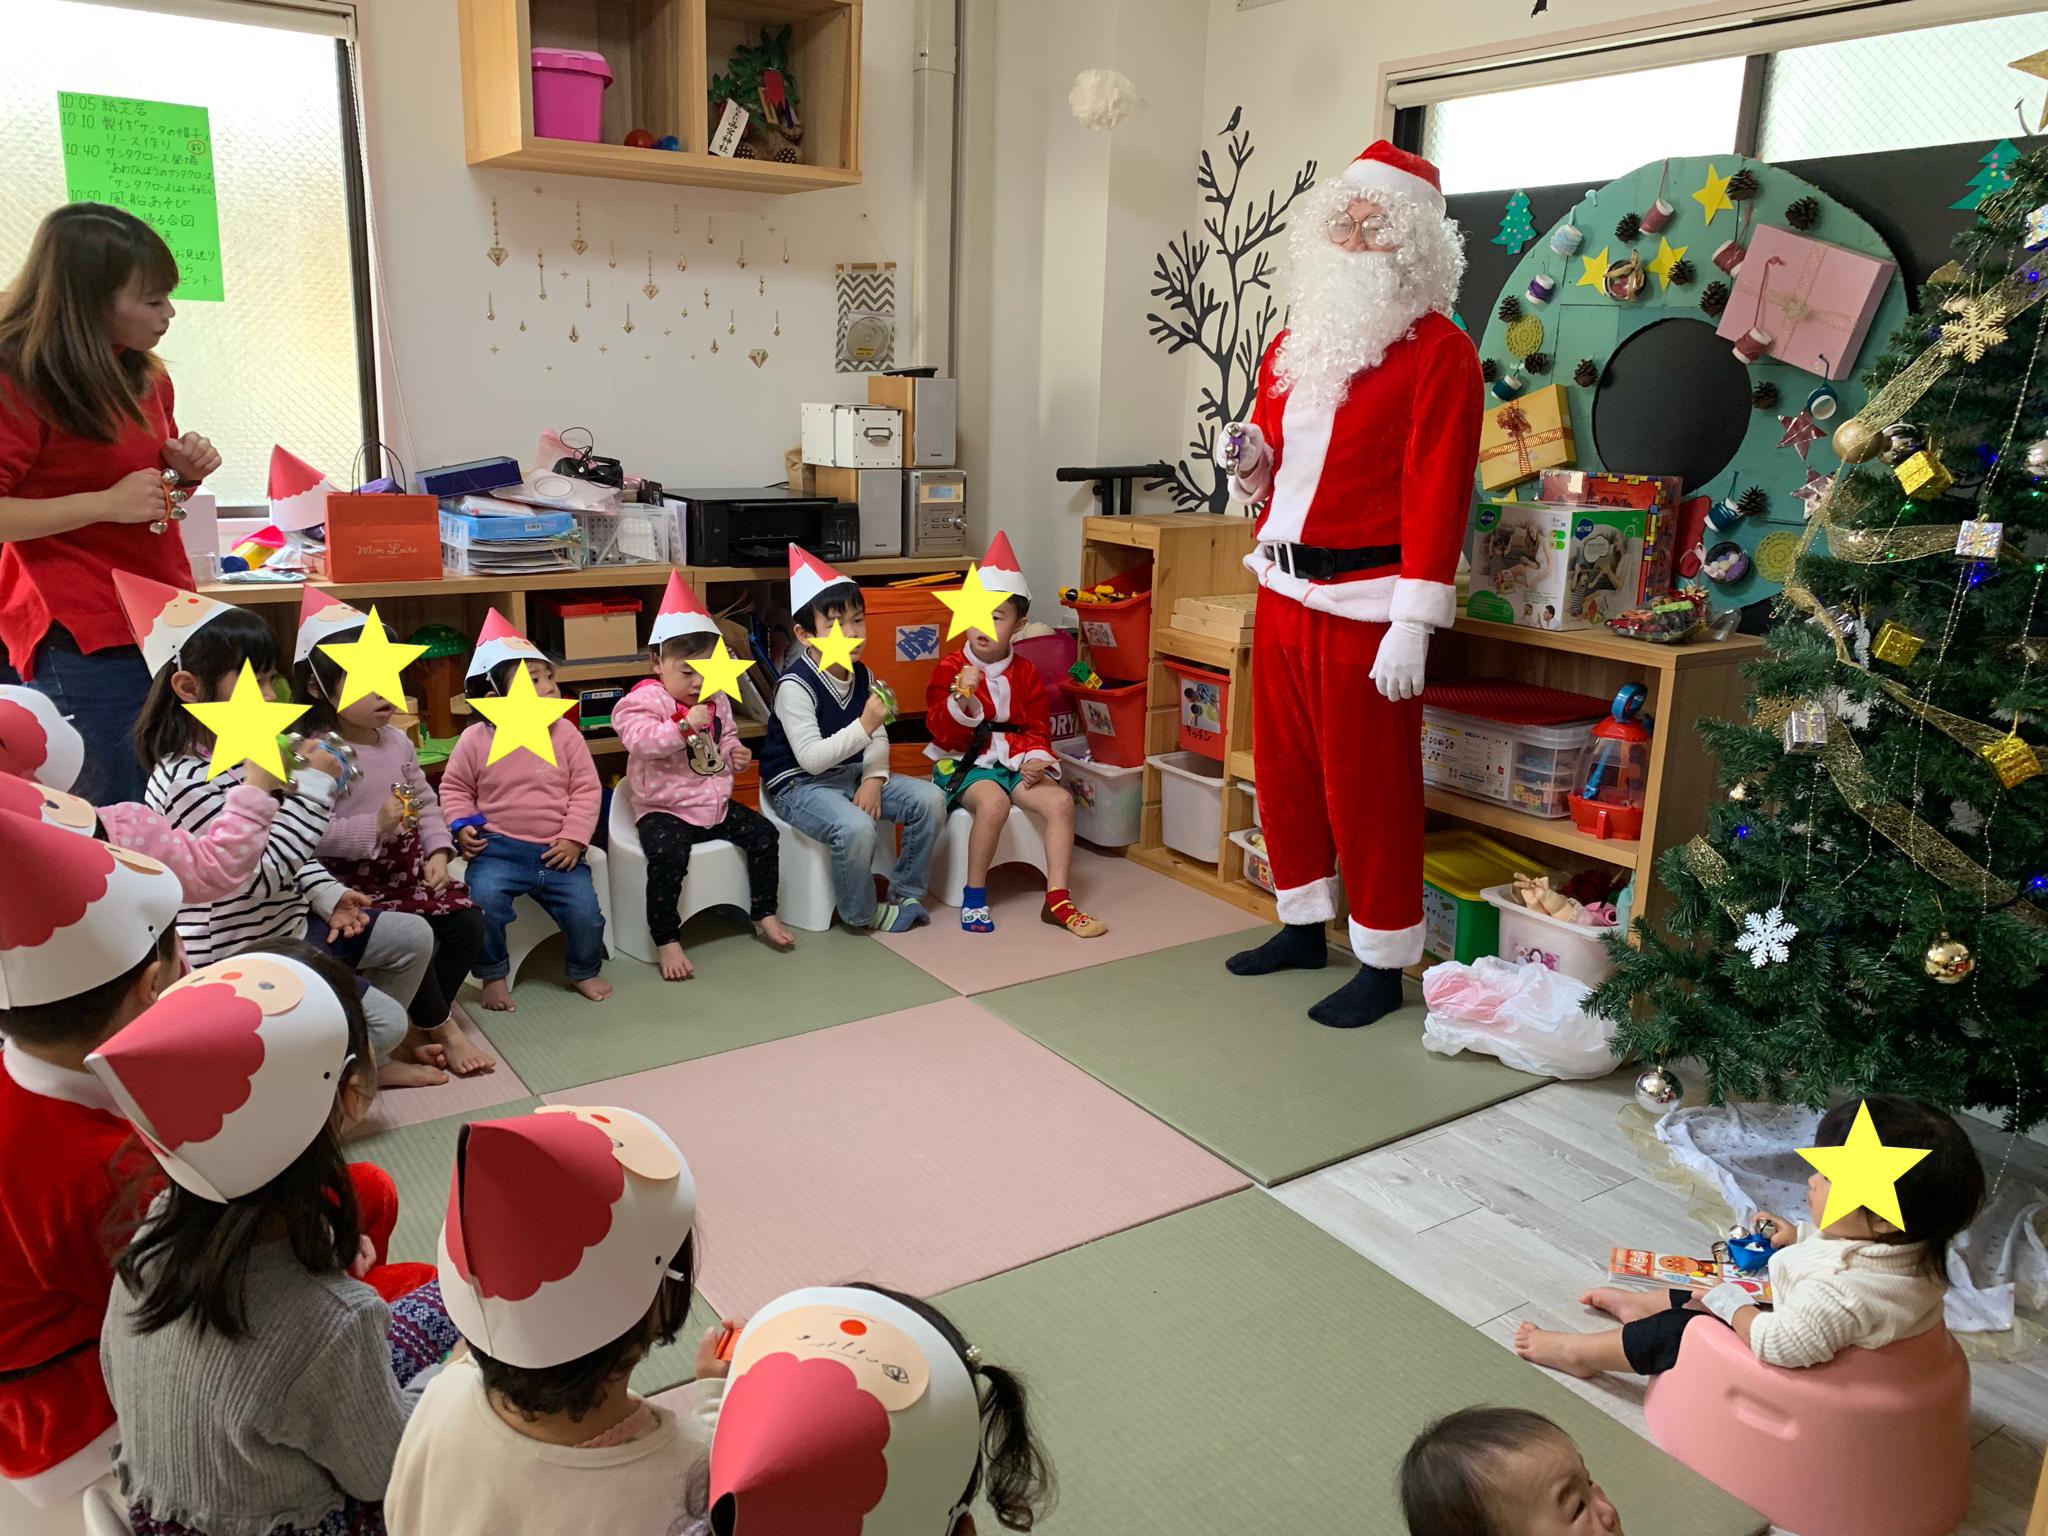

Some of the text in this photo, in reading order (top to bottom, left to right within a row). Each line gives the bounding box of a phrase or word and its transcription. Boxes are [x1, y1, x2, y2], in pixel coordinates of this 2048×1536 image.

[61, 93, 147, 117] 10:05 紙芝居
[62, 112, 95, 130] 10:10
[107, 133, 171, 150] リース作り
[66, 143, 198, 166] 10:40 サンタクロース登場
[71, 189, 191, 210] 10:50 風船あそび
[355, 545, 385, 555] Mon
[1185, 725, 1211, 741] キッチン
